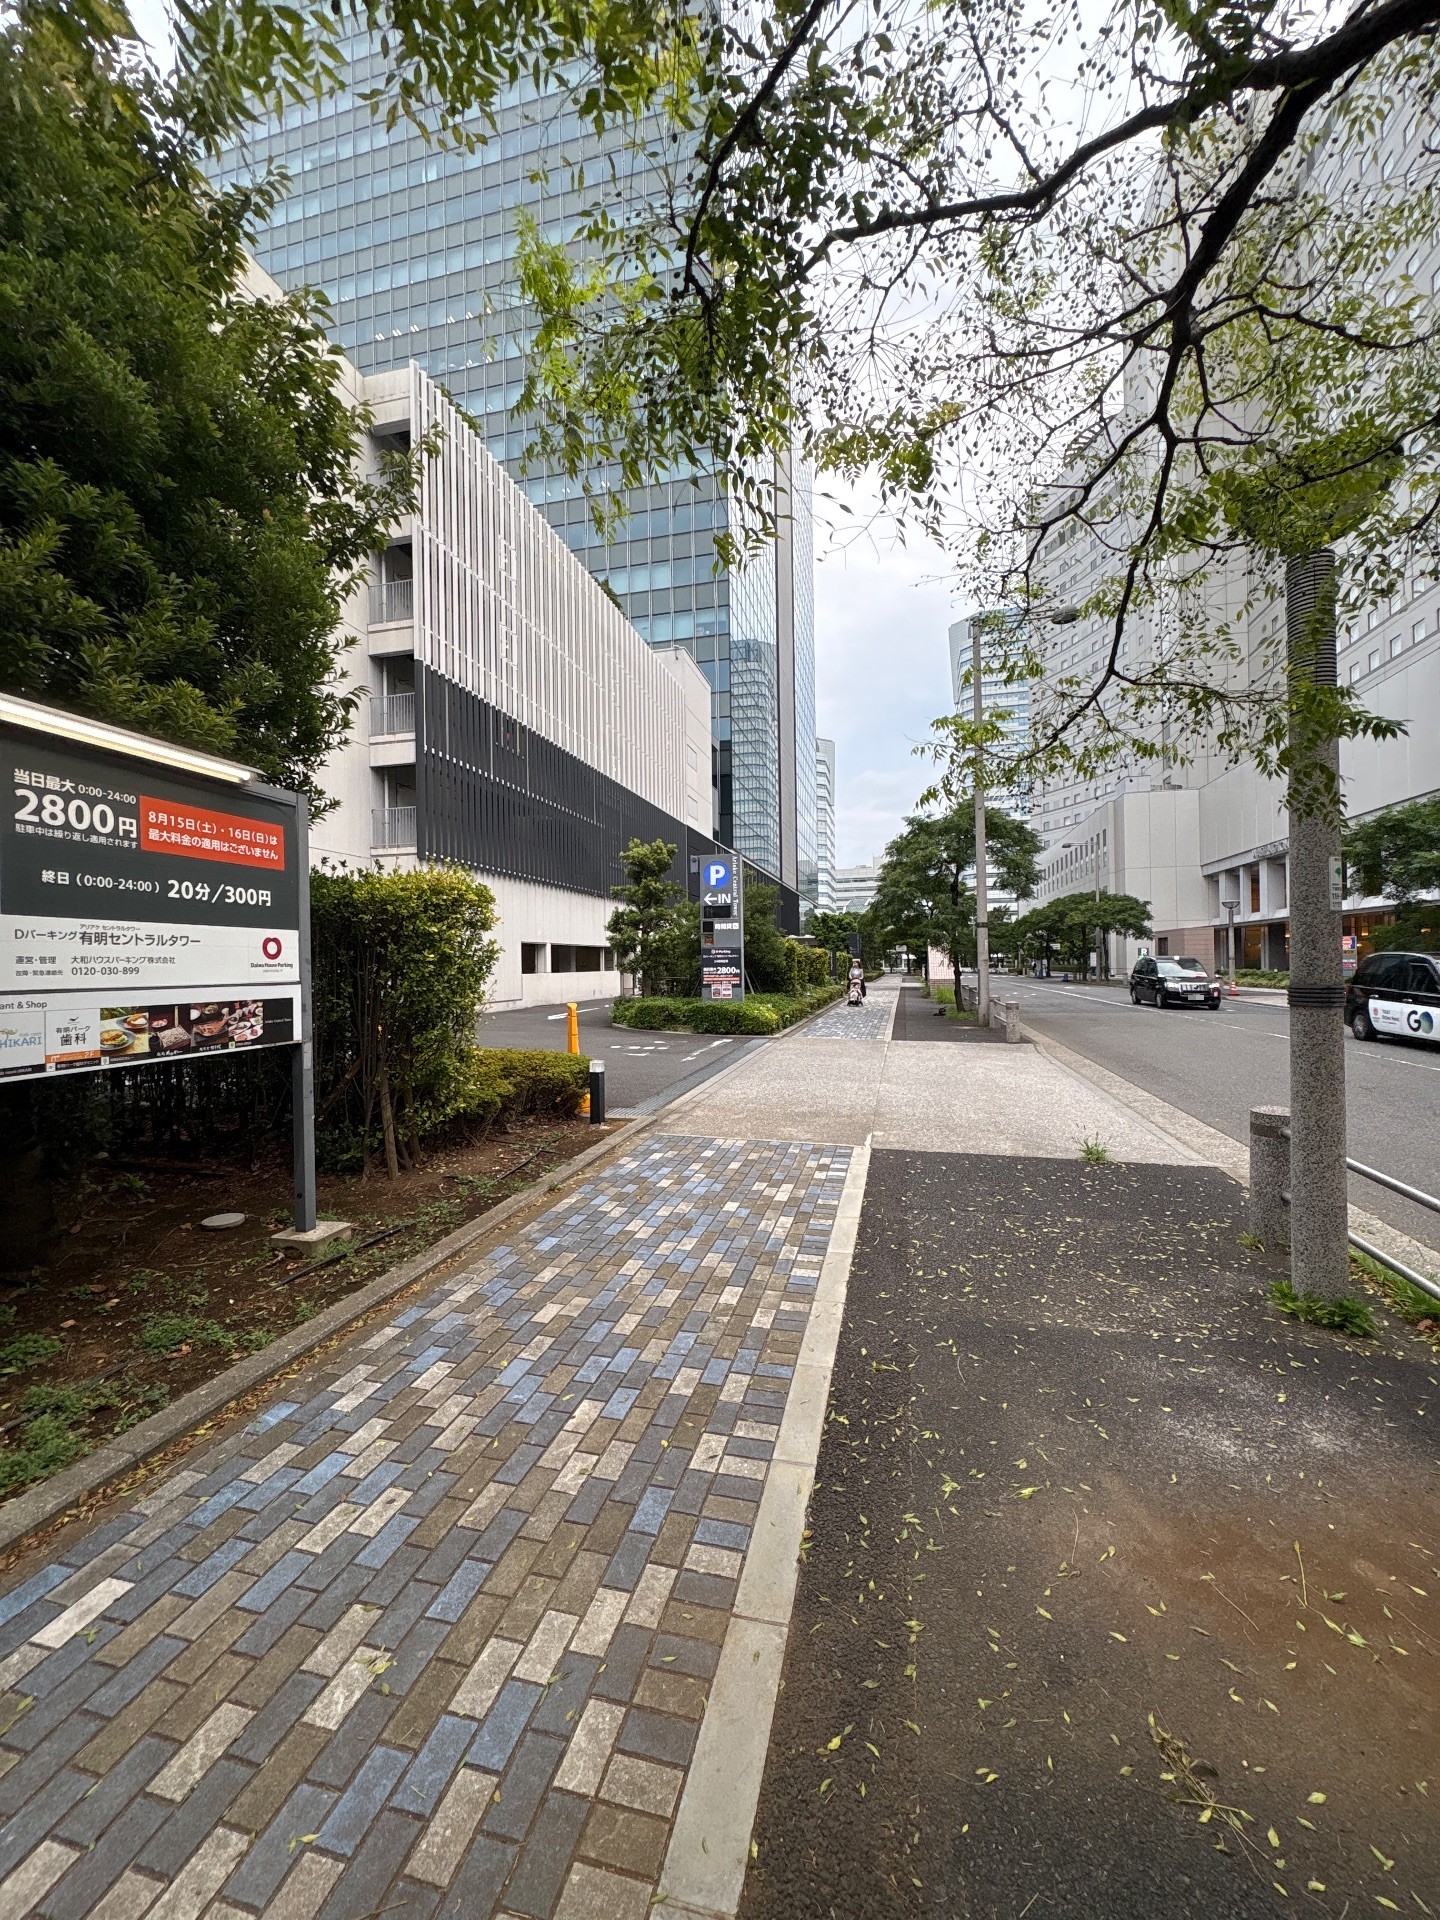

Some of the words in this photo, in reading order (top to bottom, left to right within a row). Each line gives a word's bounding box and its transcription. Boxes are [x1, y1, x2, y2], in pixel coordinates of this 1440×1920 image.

[14, 768, 76, 795] 当日最大
[78, 784, 137, 805] 0:00-24:00
[15, 823, 138, 849] 駐車中は繰り返し適用されます
[148, 829, 279, 860] 最大料金の適用はございません
[710, 865, 725, 886] P
[718, 893, 731, 904] IN
[15, 956, 57, 965] 運営・管理
[71, 956, 176, 965] 大和ハウスパーキング株式会社
[71, 967, 140, 976] 0120-030-899
[26, 1001, 48, 1009] Shop
[56, 1025, 91, 1034] 有明パーク
[60, 1032, 87, 1046] 歯科
